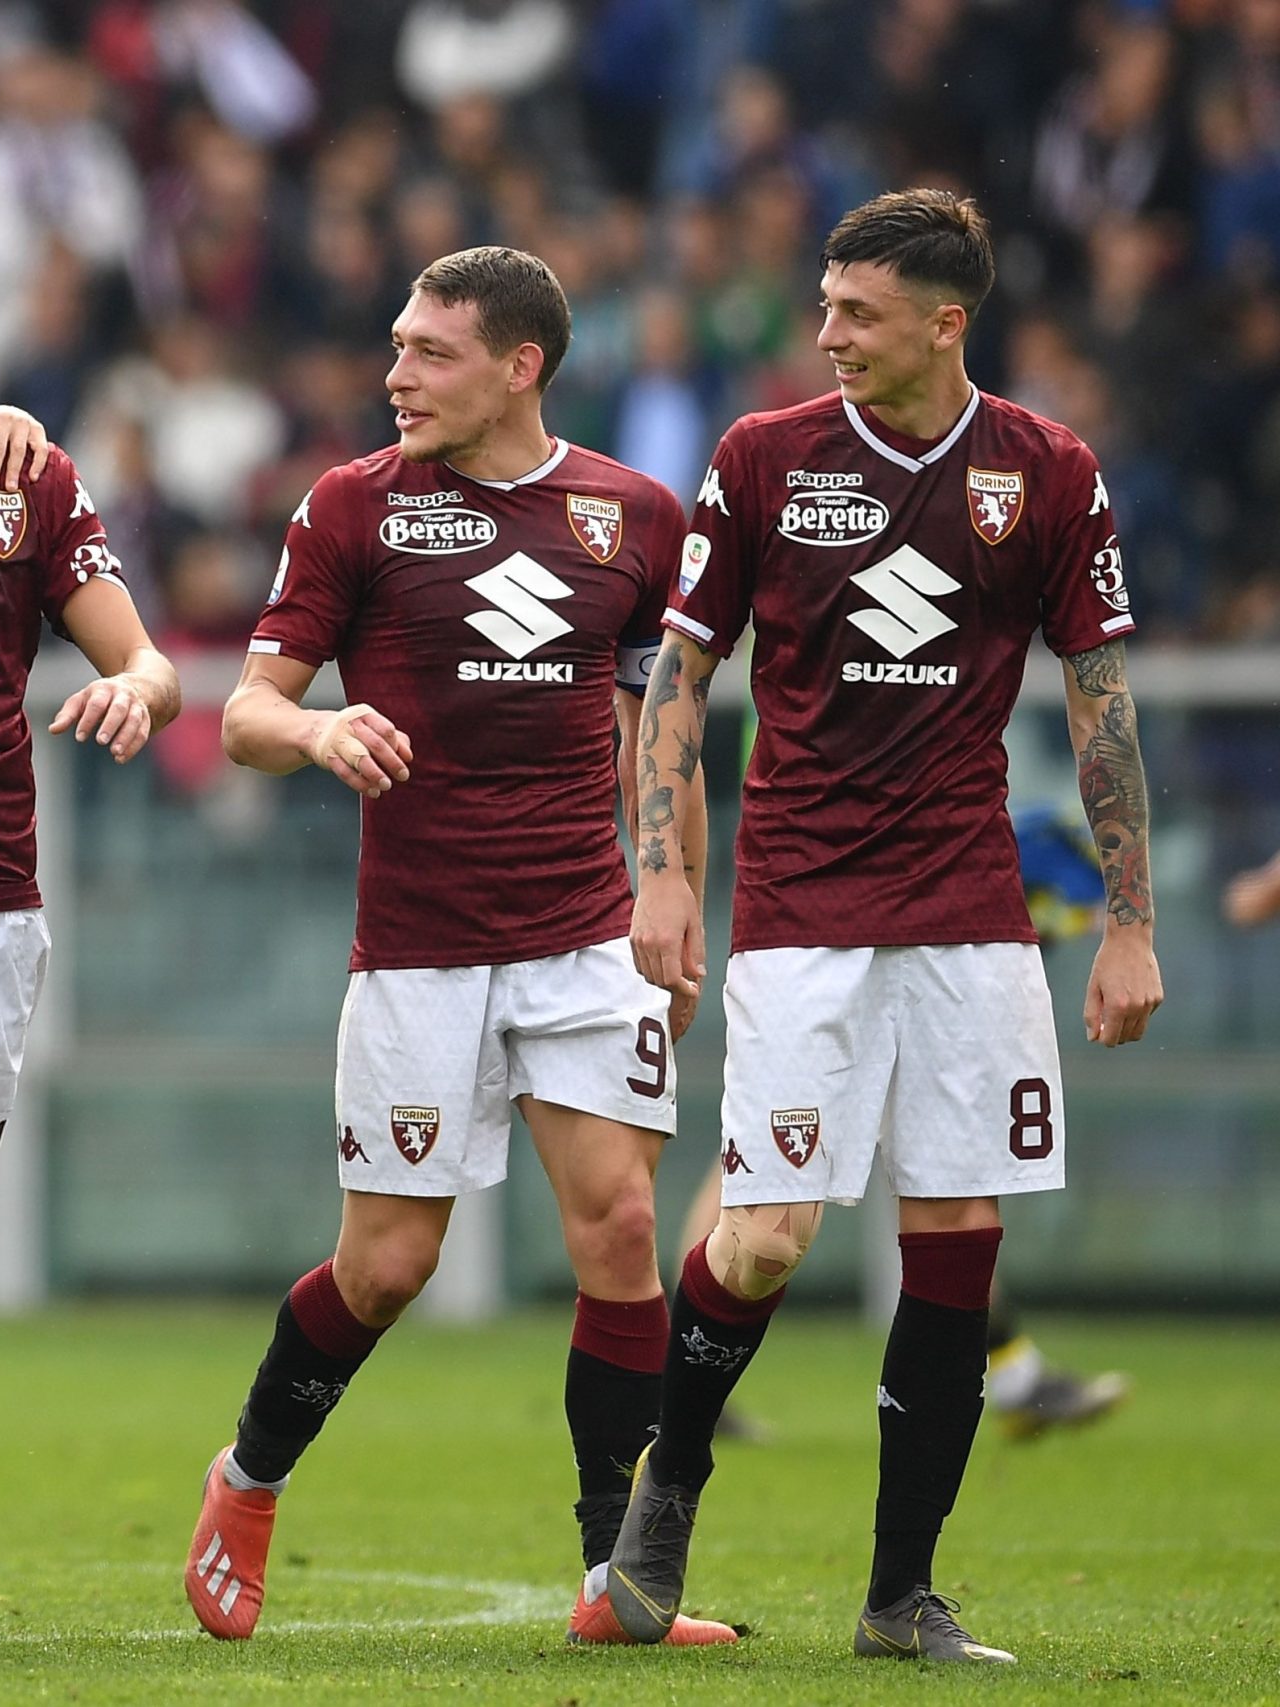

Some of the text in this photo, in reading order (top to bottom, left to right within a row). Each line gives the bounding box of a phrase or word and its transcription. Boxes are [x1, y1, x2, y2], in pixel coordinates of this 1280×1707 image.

[786, 470, 863, 489] Kappa
[972, 474, 1017, 490] TORINO
[387, 490, 464, 508] Kappa
[998, 493, 1018, 505] FC
[2, 510, 21, 522] FC
[573, 500, 617, 517] TORINO
[781, 502, 885, 532] Beretta
[388, 517, 493, 545] Beretta
[818, 531, 845, 540] 1812
[427, 540, 455, 549] 1812
[457, 661, 574, 683] SUZUKI
[841, 661, 958, 686] SUZUKI
[626, 1016, 668, 1099] 9
[395, 1110, 435, 1120] TORINO
[775, 1113, 815, 1123] TORINO
[1009, 1077, 1054, 1160] 8
[420, 1124, 434, 1133] FC
